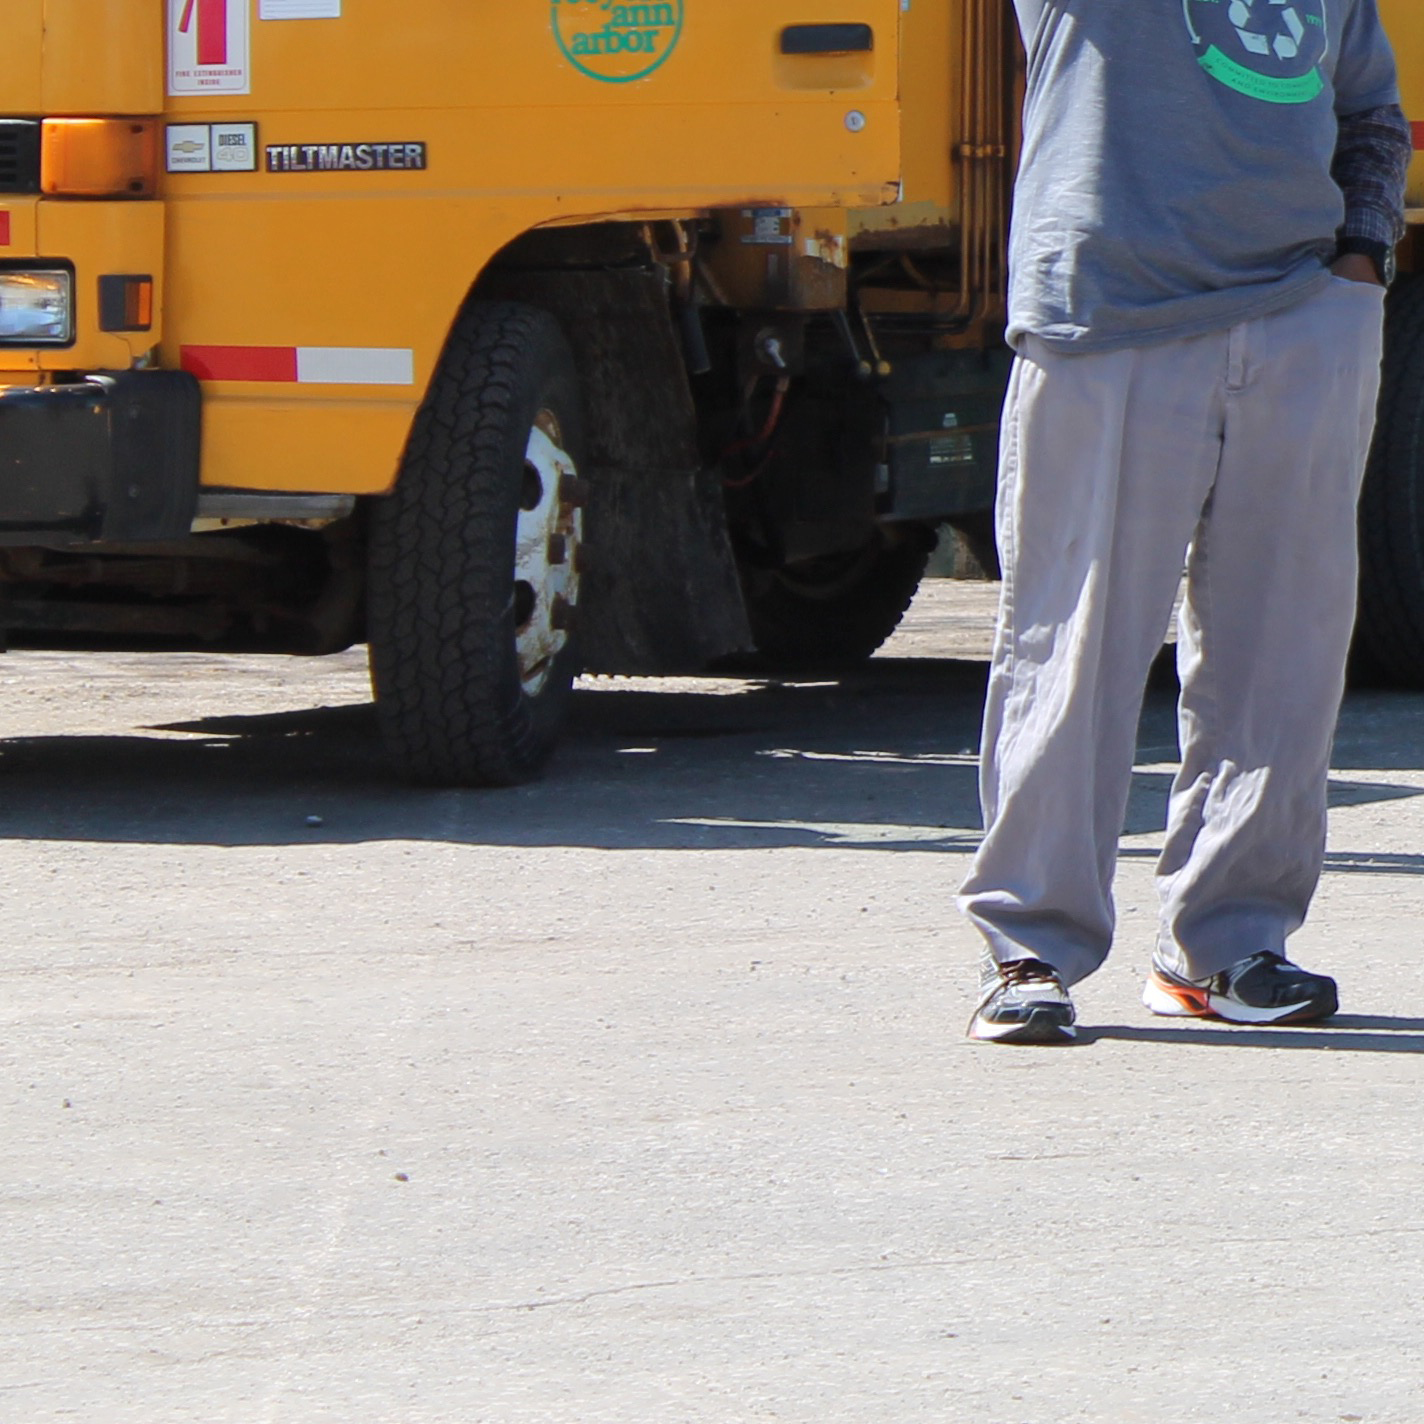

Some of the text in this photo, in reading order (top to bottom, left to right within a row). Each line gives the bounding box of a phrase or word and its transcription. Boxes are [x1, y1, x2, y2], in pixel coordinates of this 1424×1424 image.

[610, 2, 676, 27] ann
[571, 23, 660, 55] arbor
[218, 133, 247, 147] DIESEL
[217, 147, 249, 163] 40
[266, 143, 424, 171] TILTMASTER
